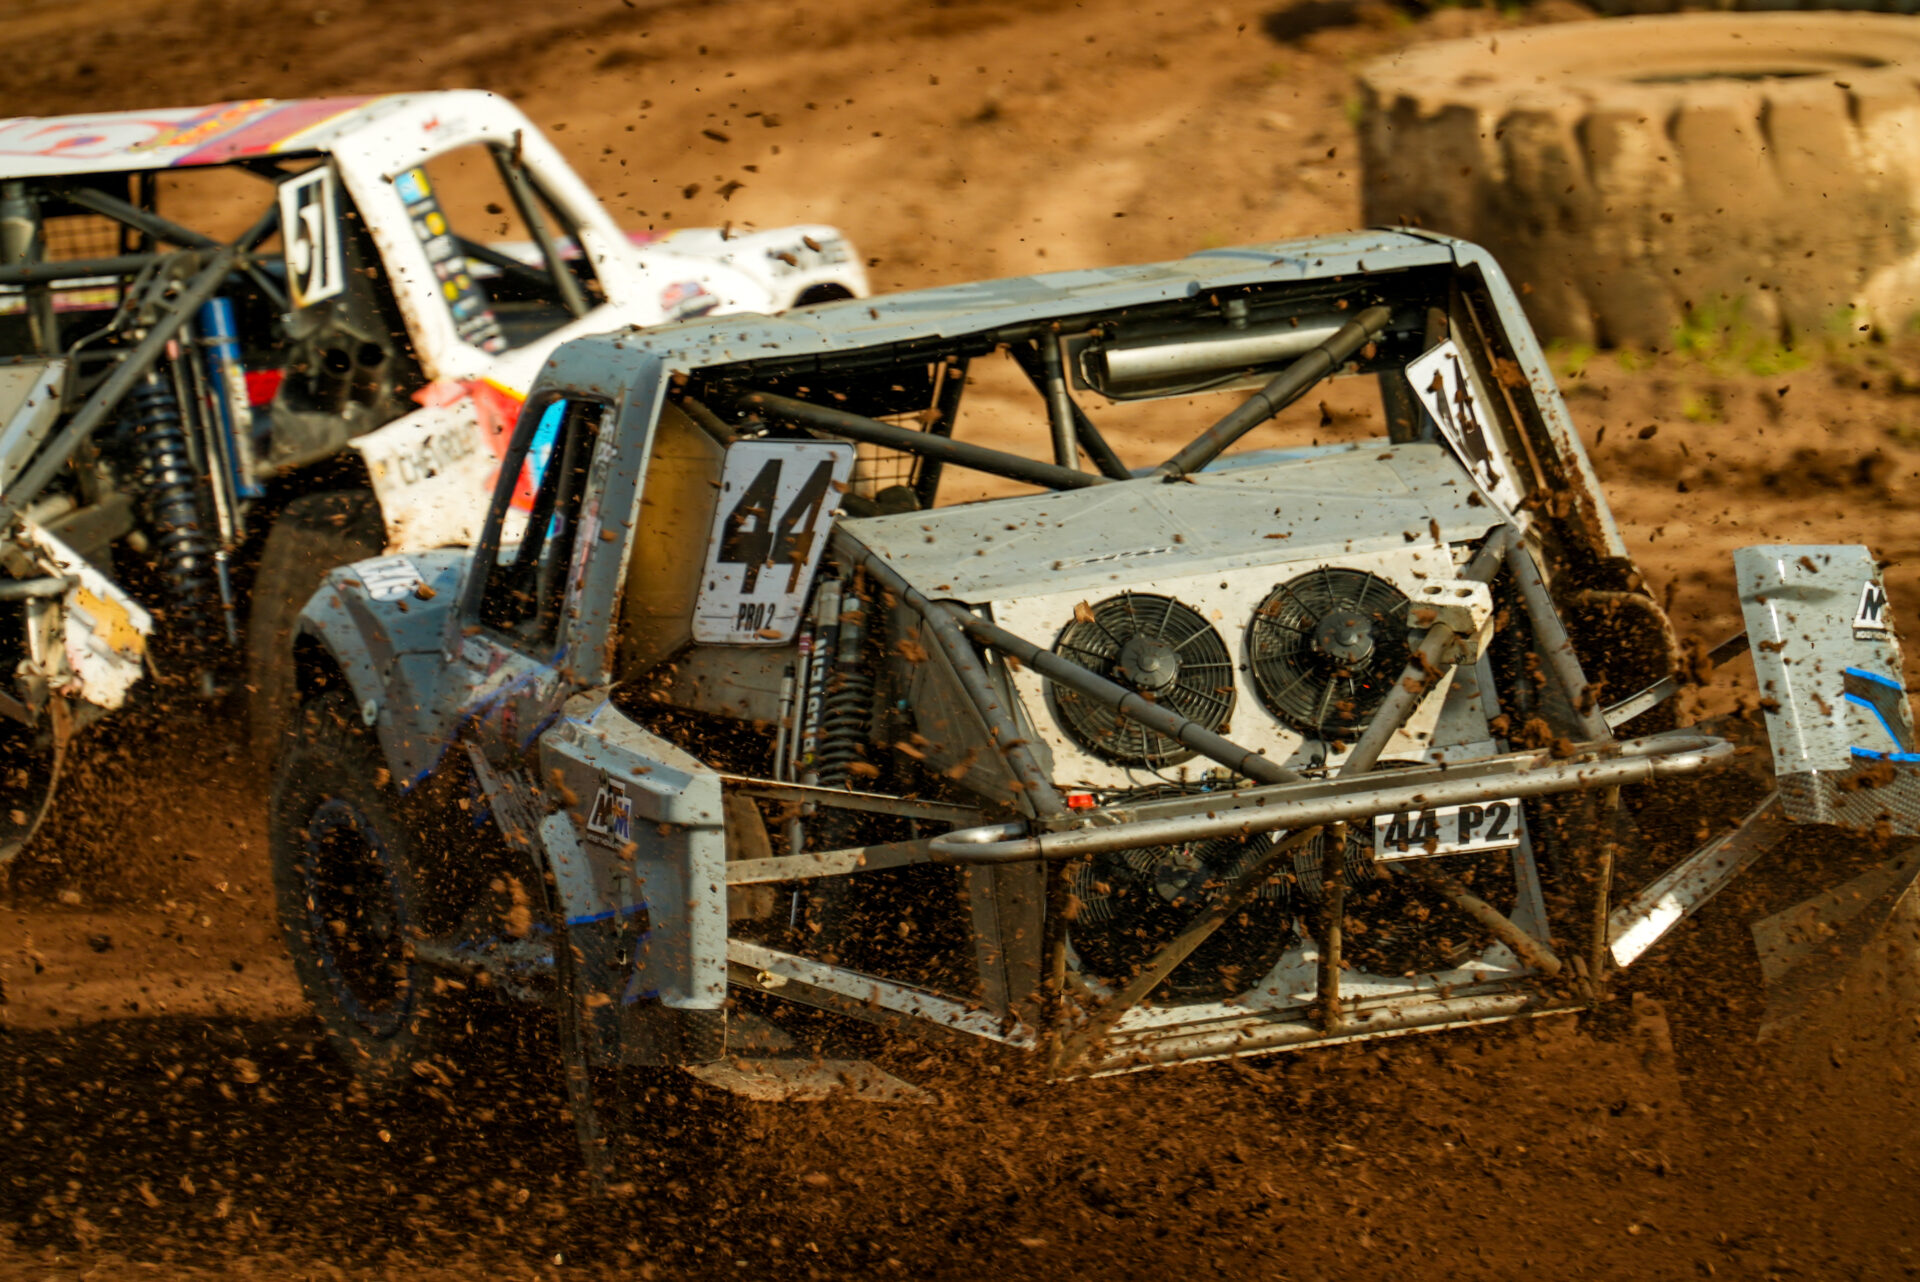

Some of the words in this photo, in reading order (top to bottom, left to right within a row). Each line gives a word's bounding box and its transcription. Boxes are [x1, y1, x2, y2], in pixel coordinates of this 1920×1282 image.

[717, 458, 835, 594] 44
[736, 602, 765, 632] PRO
[763, 602, 777, 631] 2
[1384, 808, 1440, 853] 44
[1458, 801, 1511, 845] P2
